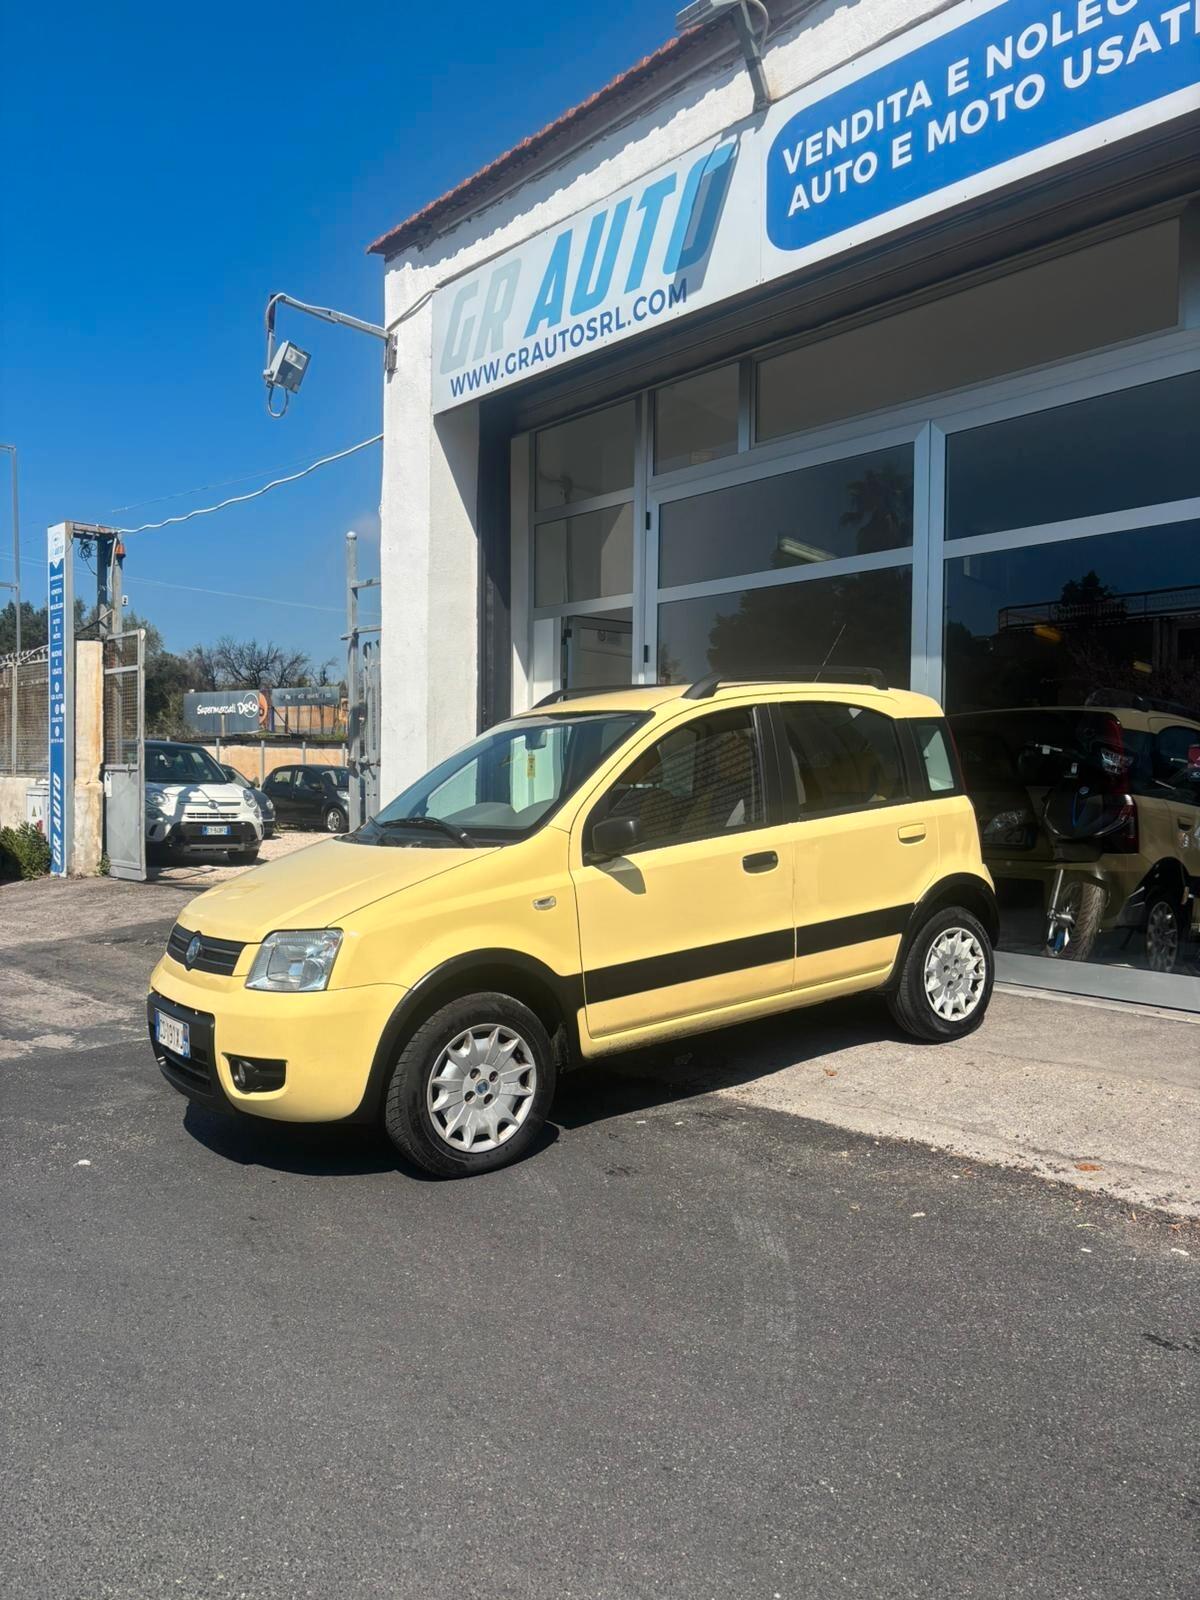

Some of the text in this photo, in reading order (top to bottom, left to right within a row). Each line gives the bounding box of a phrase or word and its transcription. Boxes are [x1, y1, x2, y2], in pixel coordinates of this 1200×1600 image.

[782, 80, 932, 174] VENDITA
[947, 58, 970, 96] E
[787, 151, 878, 217] AUTO
[892, 132, 912, 169] E
[927, 73, 1045, 152] MOTO
[439, 141, 738, 376] GR AUTO
[450, 277, 688, 398] WWW.GRAUTOSRL.COM
[53, 772, 61, 866] GR AUTO
